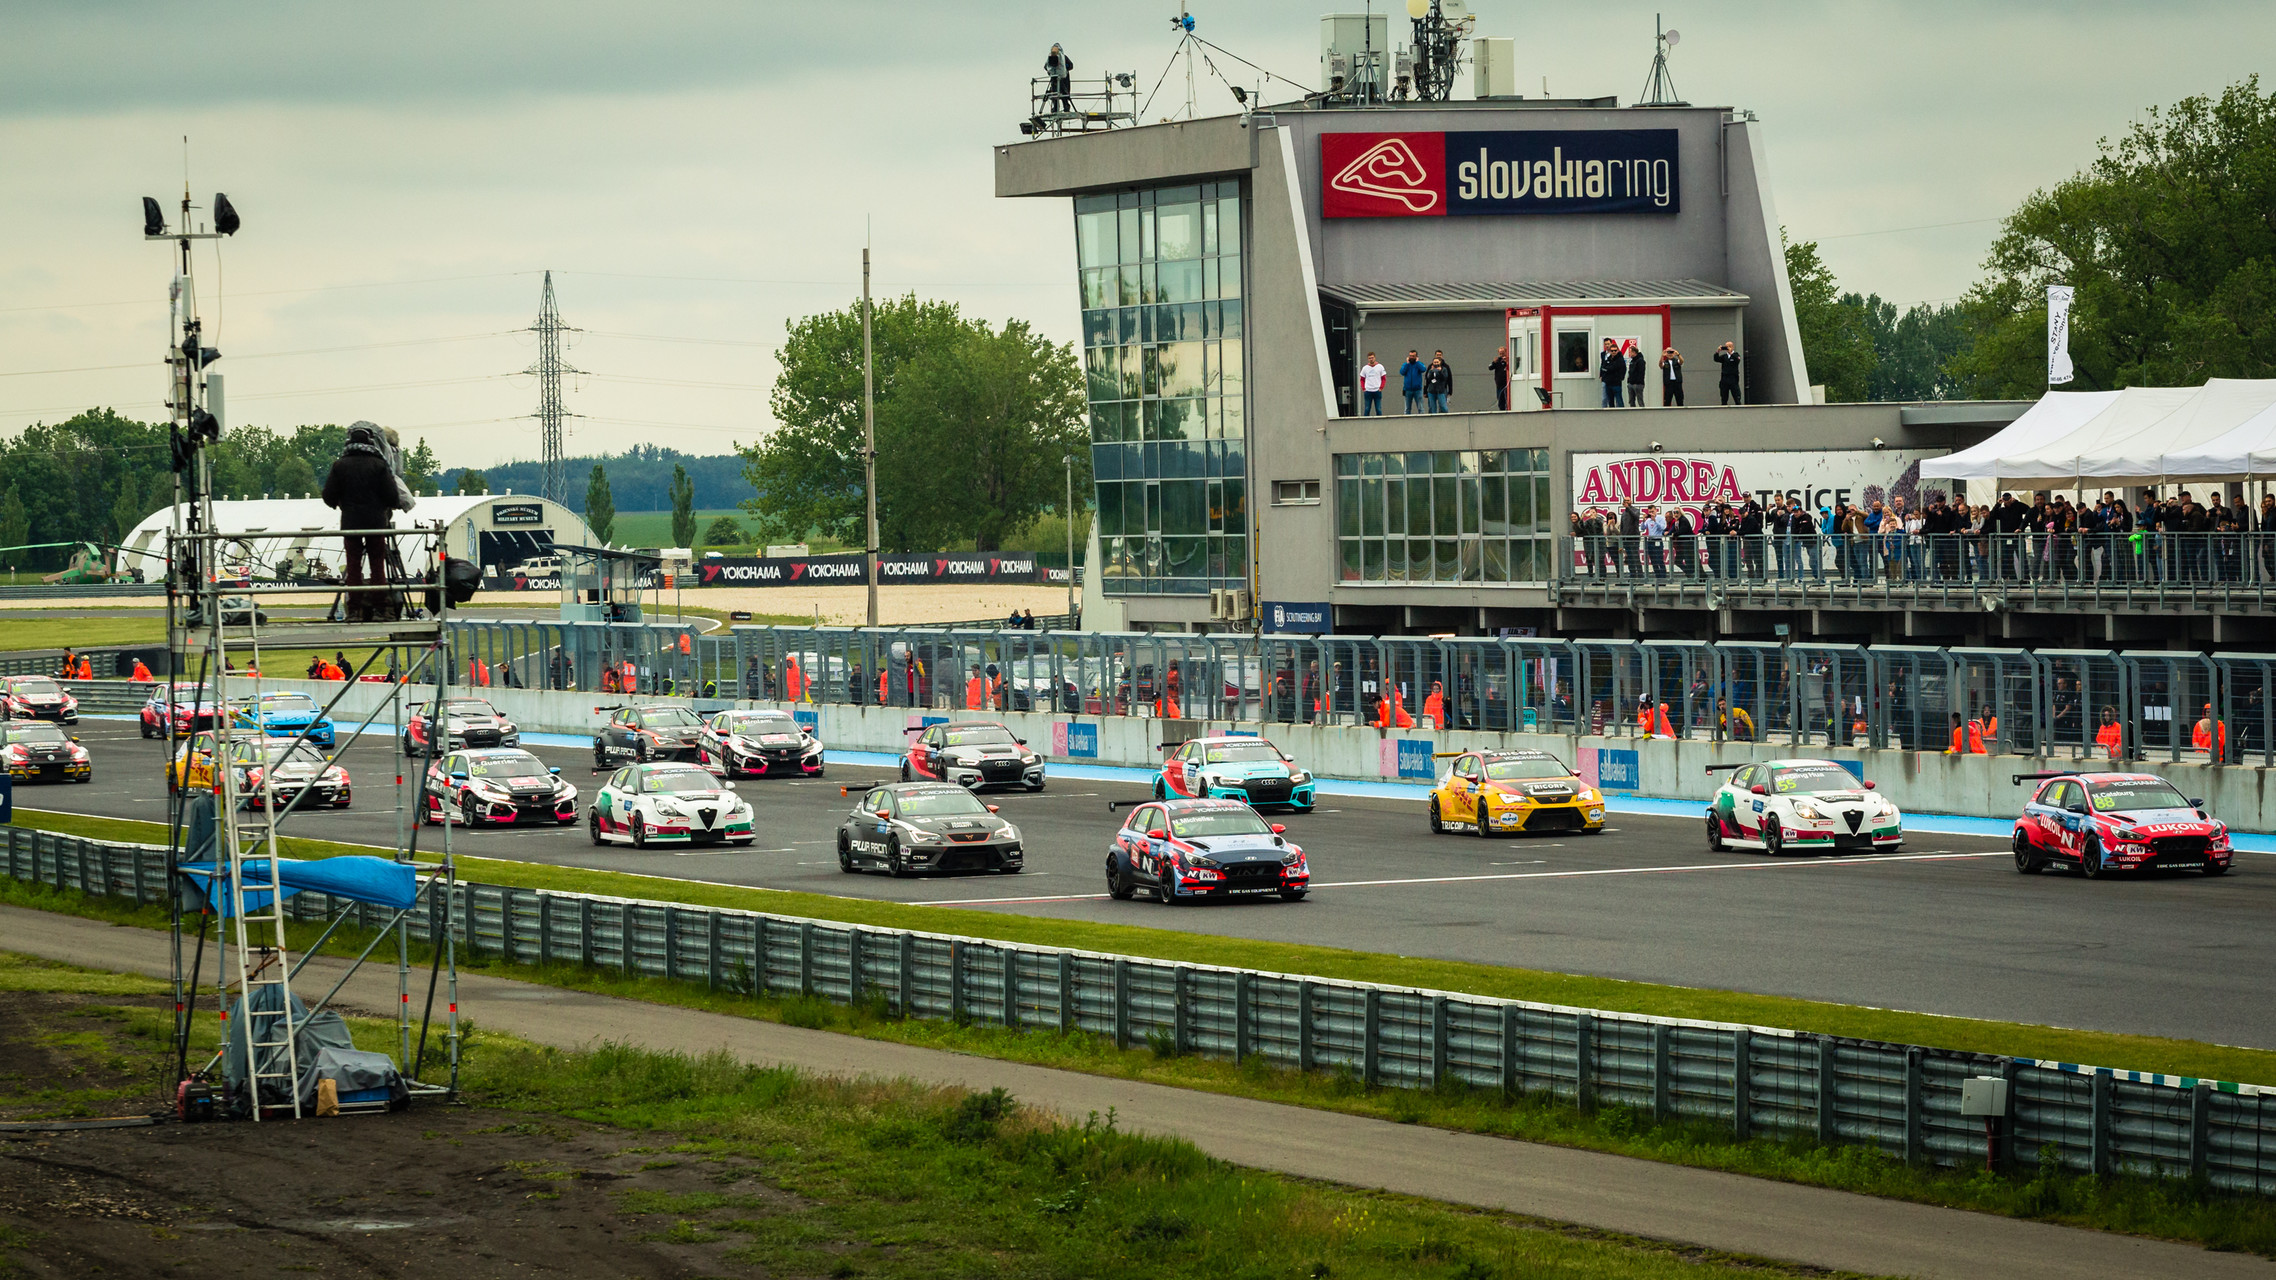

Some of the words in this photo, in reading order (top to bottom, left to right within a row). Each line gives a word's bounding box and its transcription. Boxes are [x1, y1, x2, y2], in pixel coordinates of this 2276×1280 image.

[1458, 146, 1670, 207] slovakiaring
[1578, 457, 1747, 505] ANDREA
[1755, 483, 1851, 512] TSÍCE
[722, 566, 781, 580] YOKOHAMA
[807, 563, 860, 578] YOKOHAMA
[883, 561, 929, 576] YOKOHAMA
[947, 560, 985, 574] YOKOHAMA
[1000, 560, 1033, 574] YOKOHAMA
[527, 578, 562, 589] YOKOHA
[734, 724, 747, 734] 29
[948, 735, 962, 745] 22
[480, 758, 518, 766] Guerrieri
[1207, 751, 1223, 762] 69
[472, 765, 488, 775] 86
[650, 779, 665, 789] 31
[1777, 778, 1797, 791] 55
[902, 801, 918, 812] 37
[2094, 796, 2116, 809] 88
[1174, 822, 1186, 835] 5
[1441, 821, 1464, 830] TRICORP
[2040, 814, 2062, 837] LUKOIL
[2147, 823, 2204, 833] LUKOIL
[851, 840, 870, 852] PWR
[870, 842, 888, 855] RACIN
[1142, 855, 1153, 876] N
